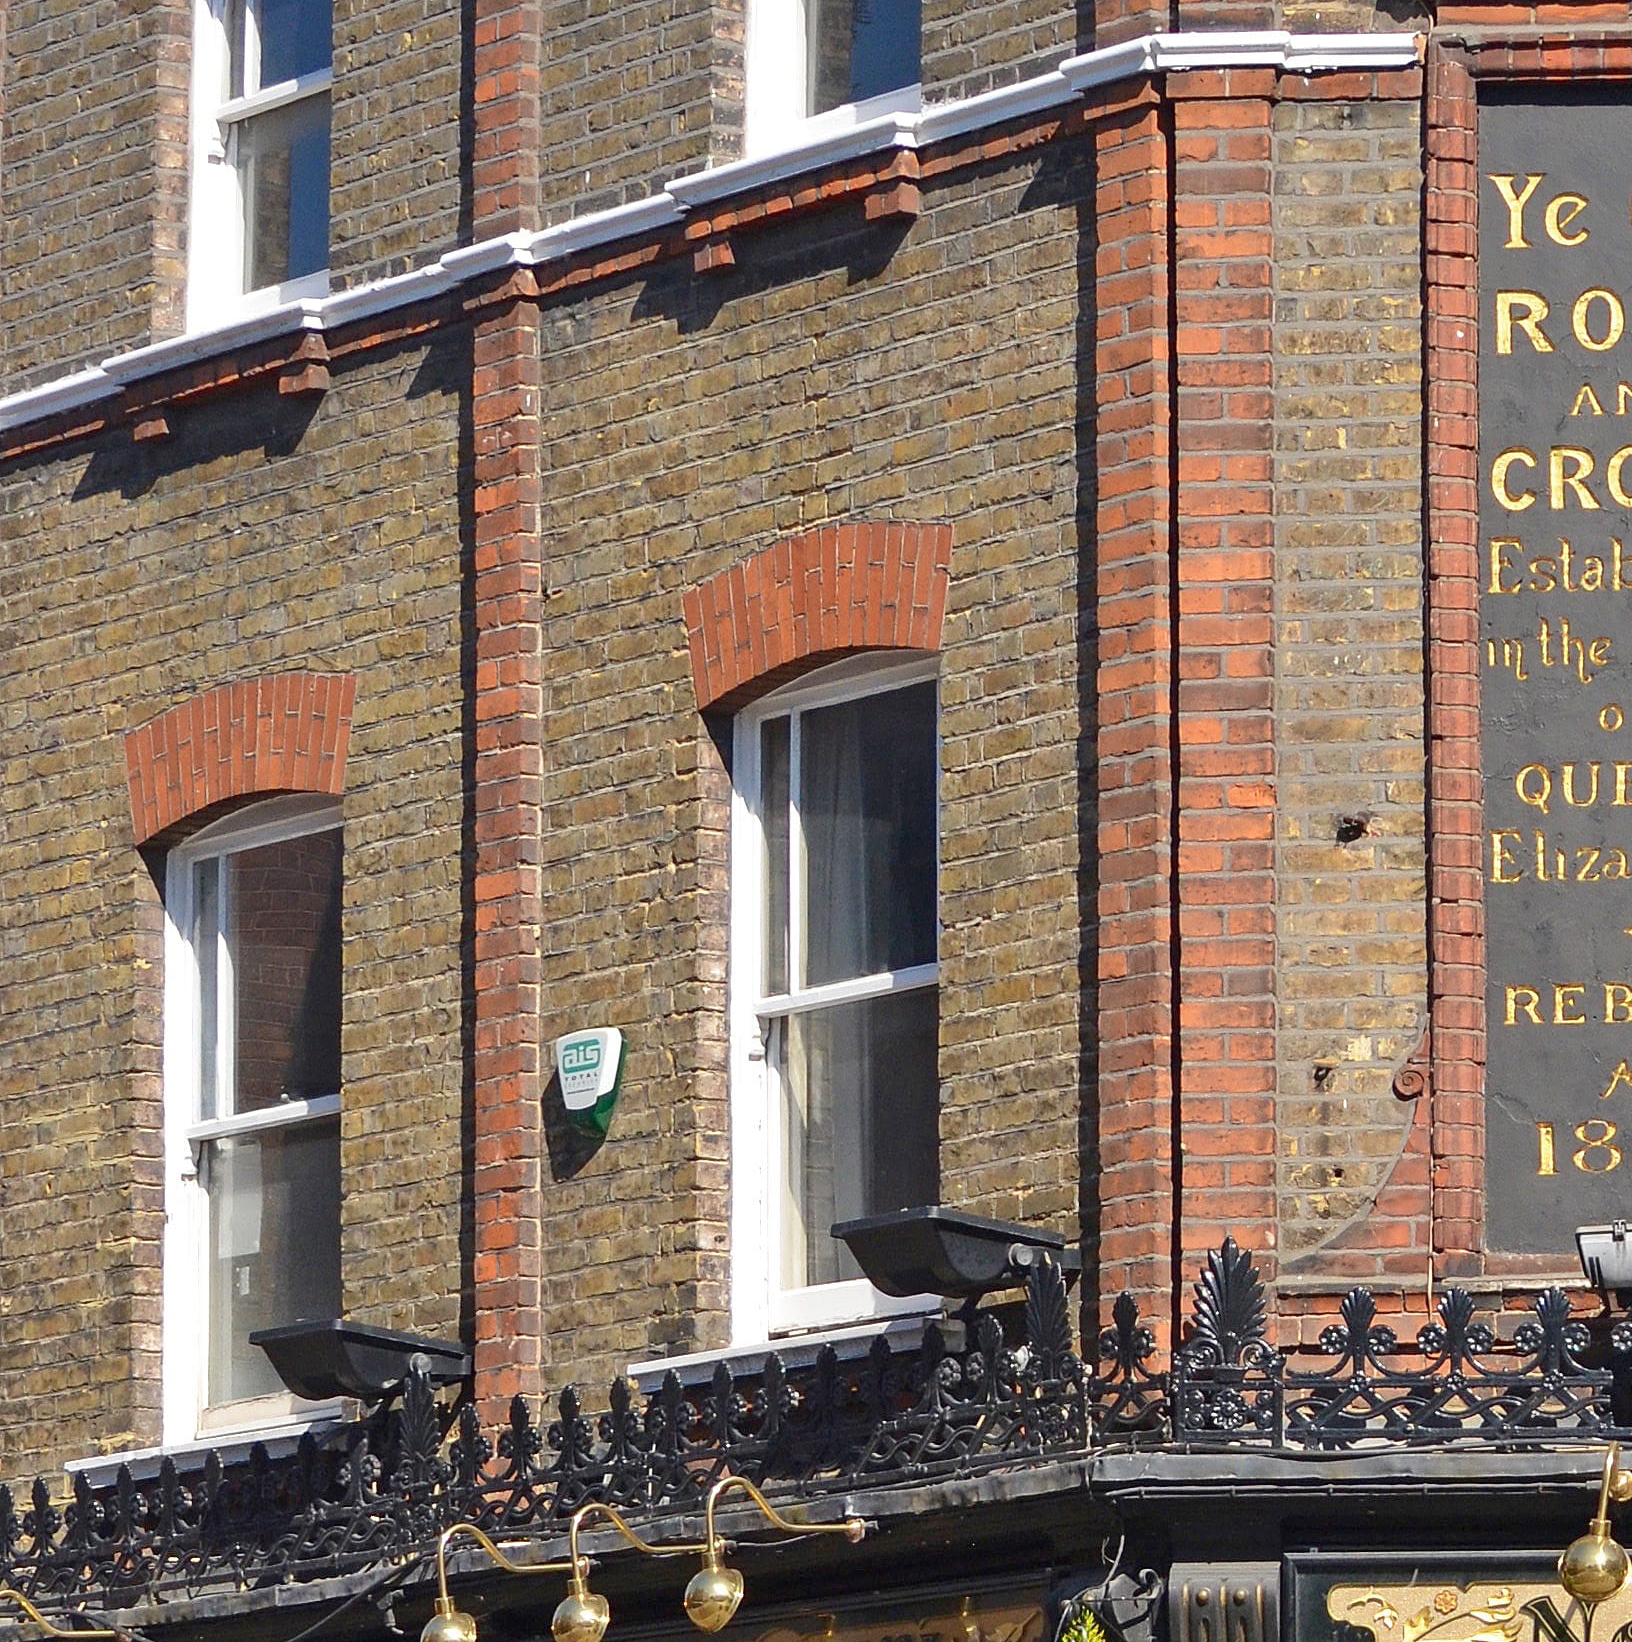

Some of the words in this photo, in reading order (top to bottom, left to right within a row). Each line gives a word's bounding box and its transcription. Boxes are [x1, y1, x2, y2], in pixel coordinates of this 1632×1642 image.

[1485, 172, 1591, 248] Ye
[1486, 637, 1529, 682] in
[1537, 616, 1612, 684] the
